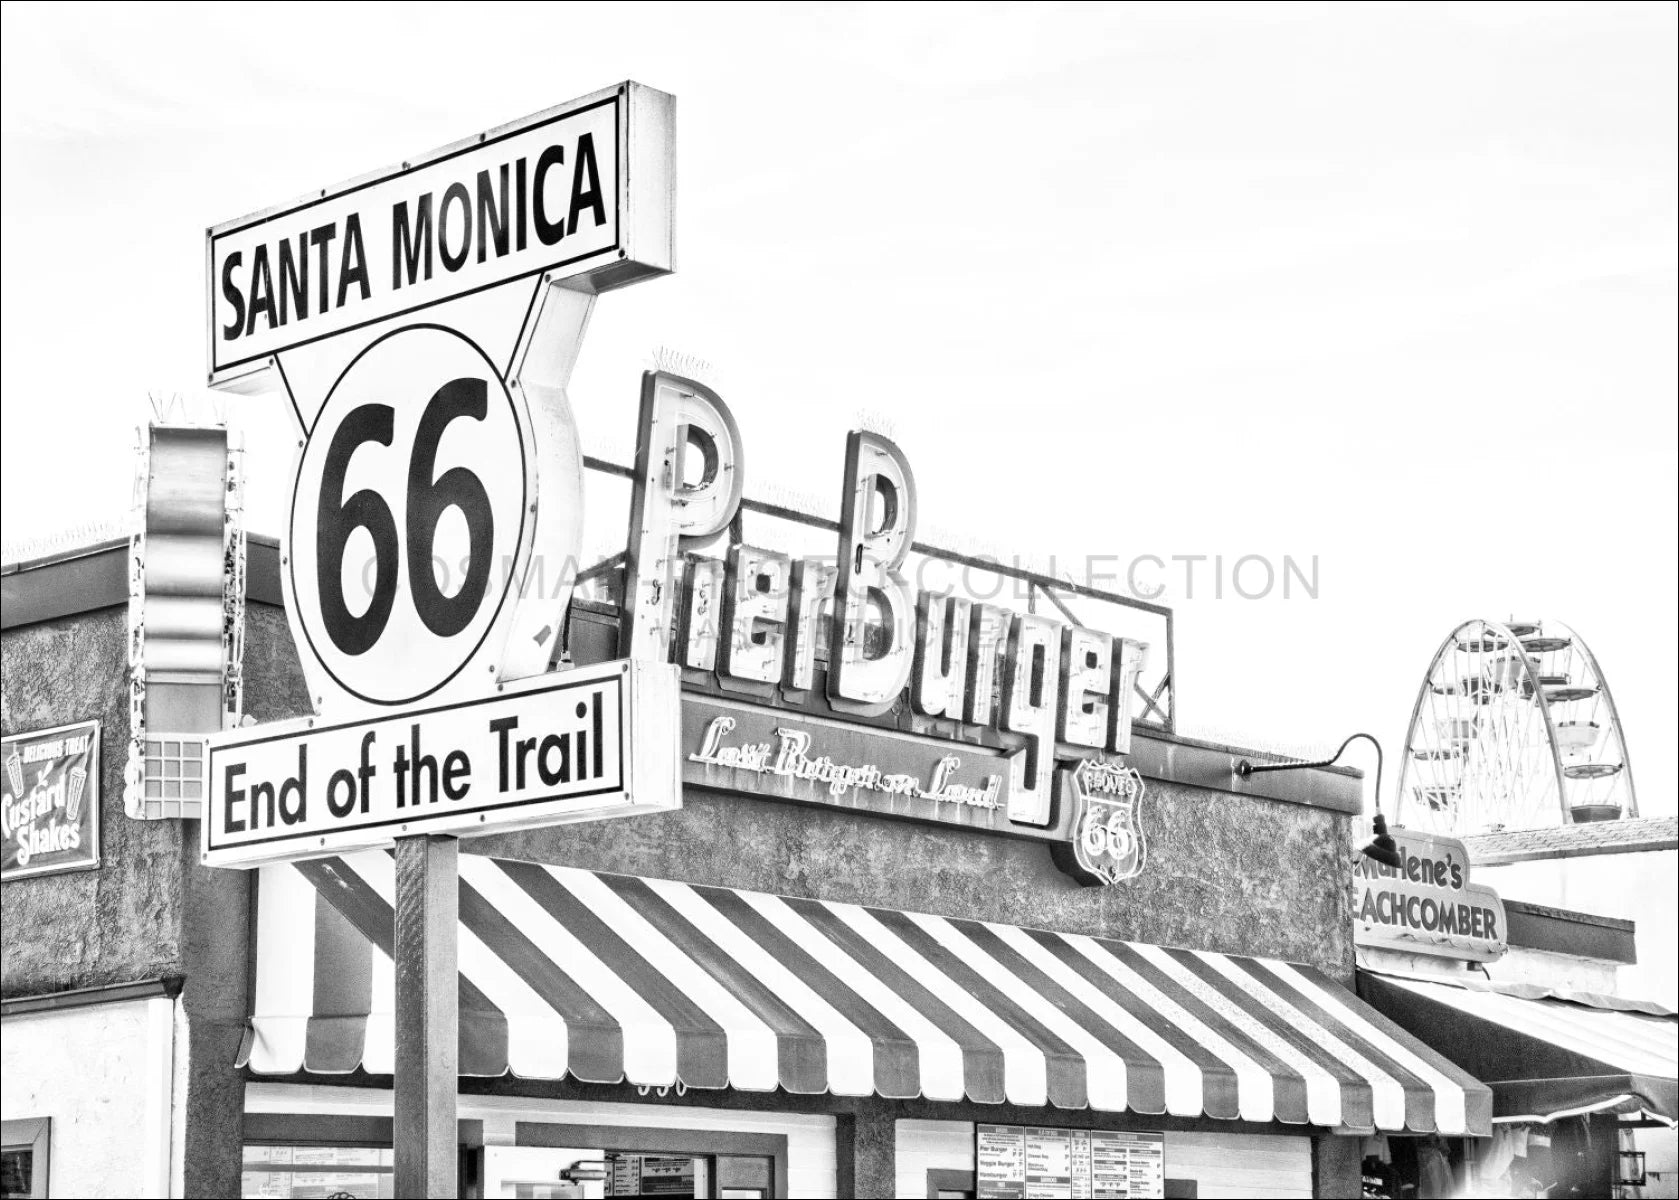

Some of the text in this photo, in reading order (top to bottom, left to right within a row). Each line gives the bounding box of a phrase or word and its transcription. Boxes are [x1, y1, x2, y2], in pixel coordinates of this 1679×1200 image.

[222, 132, 606, 341] SANTA MONICA
[316, 377, 494, 656] 66
[1, 766, 66, 839] Custard
[224, 692, 603, 834] End of the Trail
[17, 818, 80, 866] Shakes
[1081, 805, 1136, 860] 66
